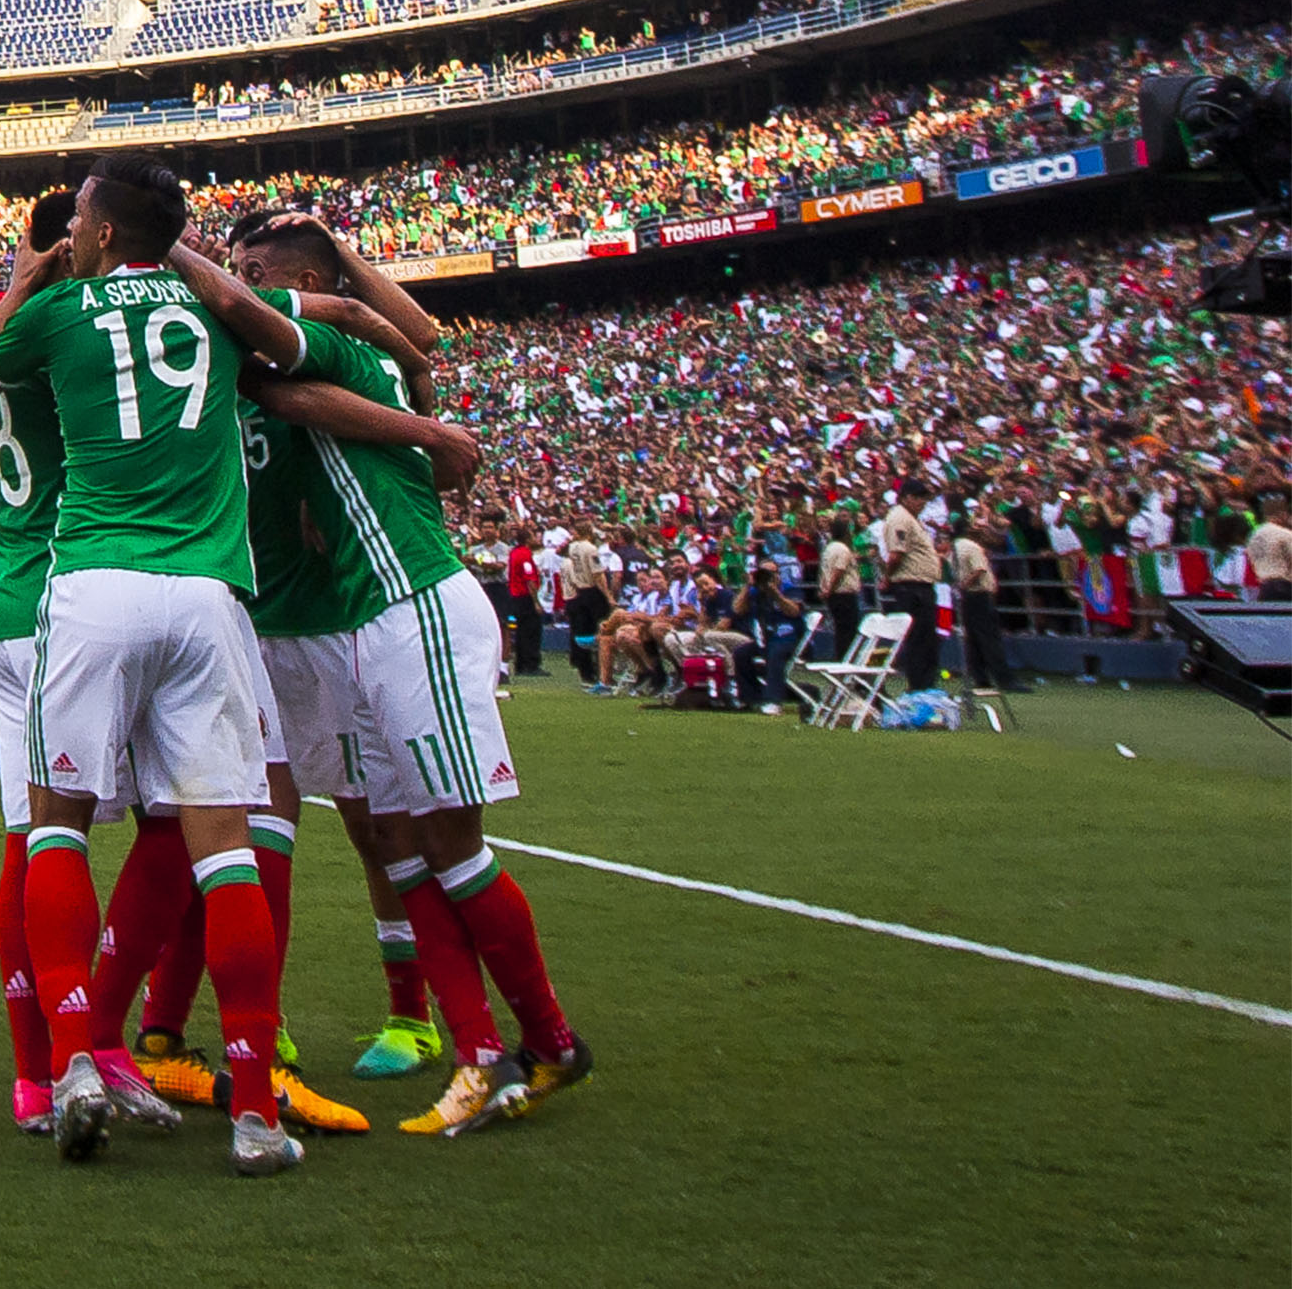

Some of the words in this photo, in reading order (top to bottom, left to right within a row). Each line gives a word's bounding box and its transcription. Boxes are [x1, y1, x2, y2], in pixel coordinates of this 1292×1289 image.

[988, 156, 1077, 193] GEICO
[816, 185, 904, 219] CYMER
[662, 217, 734, 243] TOSHIBA
[81, 283, 103, 310] A.
[106, 277, 201, 307] SEPULVE
[93, 304, 210, 440] 19
[405, 734, 452, 796] 11
